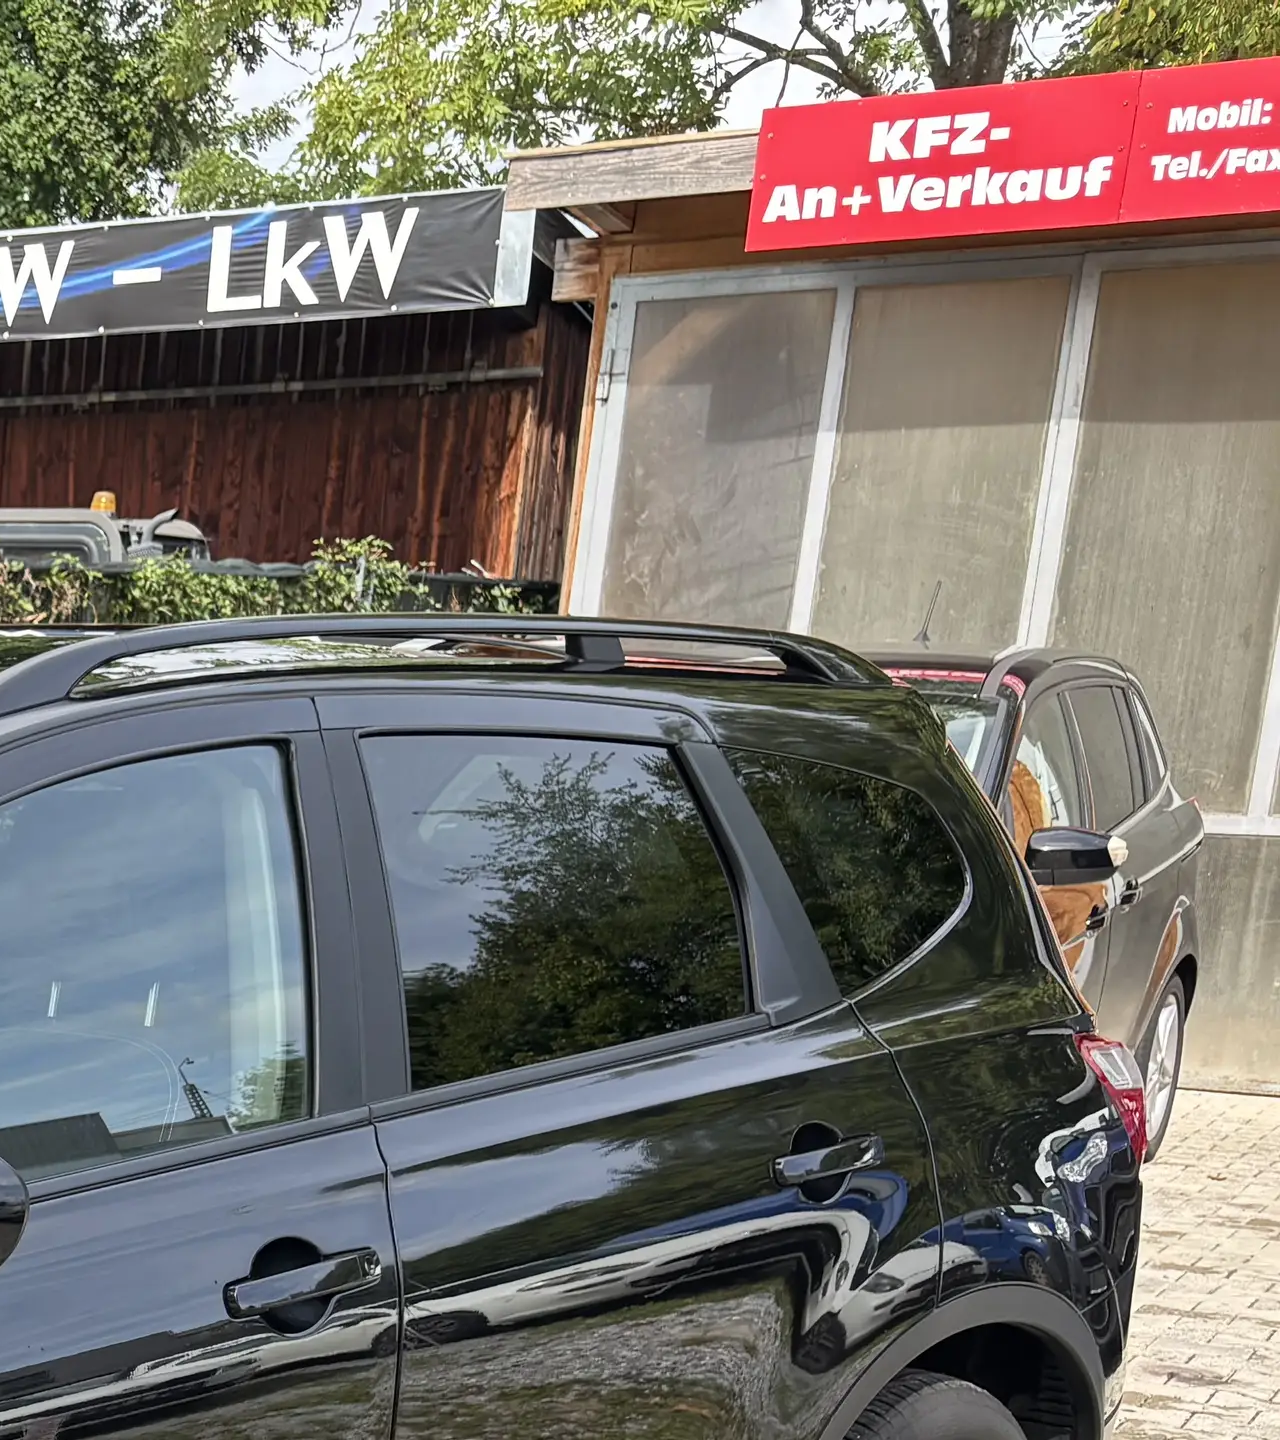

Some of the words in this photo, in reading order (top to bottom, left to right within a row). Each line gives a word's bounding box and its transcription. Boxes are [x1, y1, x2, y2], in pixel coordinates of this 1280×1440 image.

[867, 111, 1011, 163] KFZ-
[1167, 97, 1273, 134] Mobil:
[761, 156, 1115, 224] An+Verkauf
[206, 207, 420, 313] LkW
